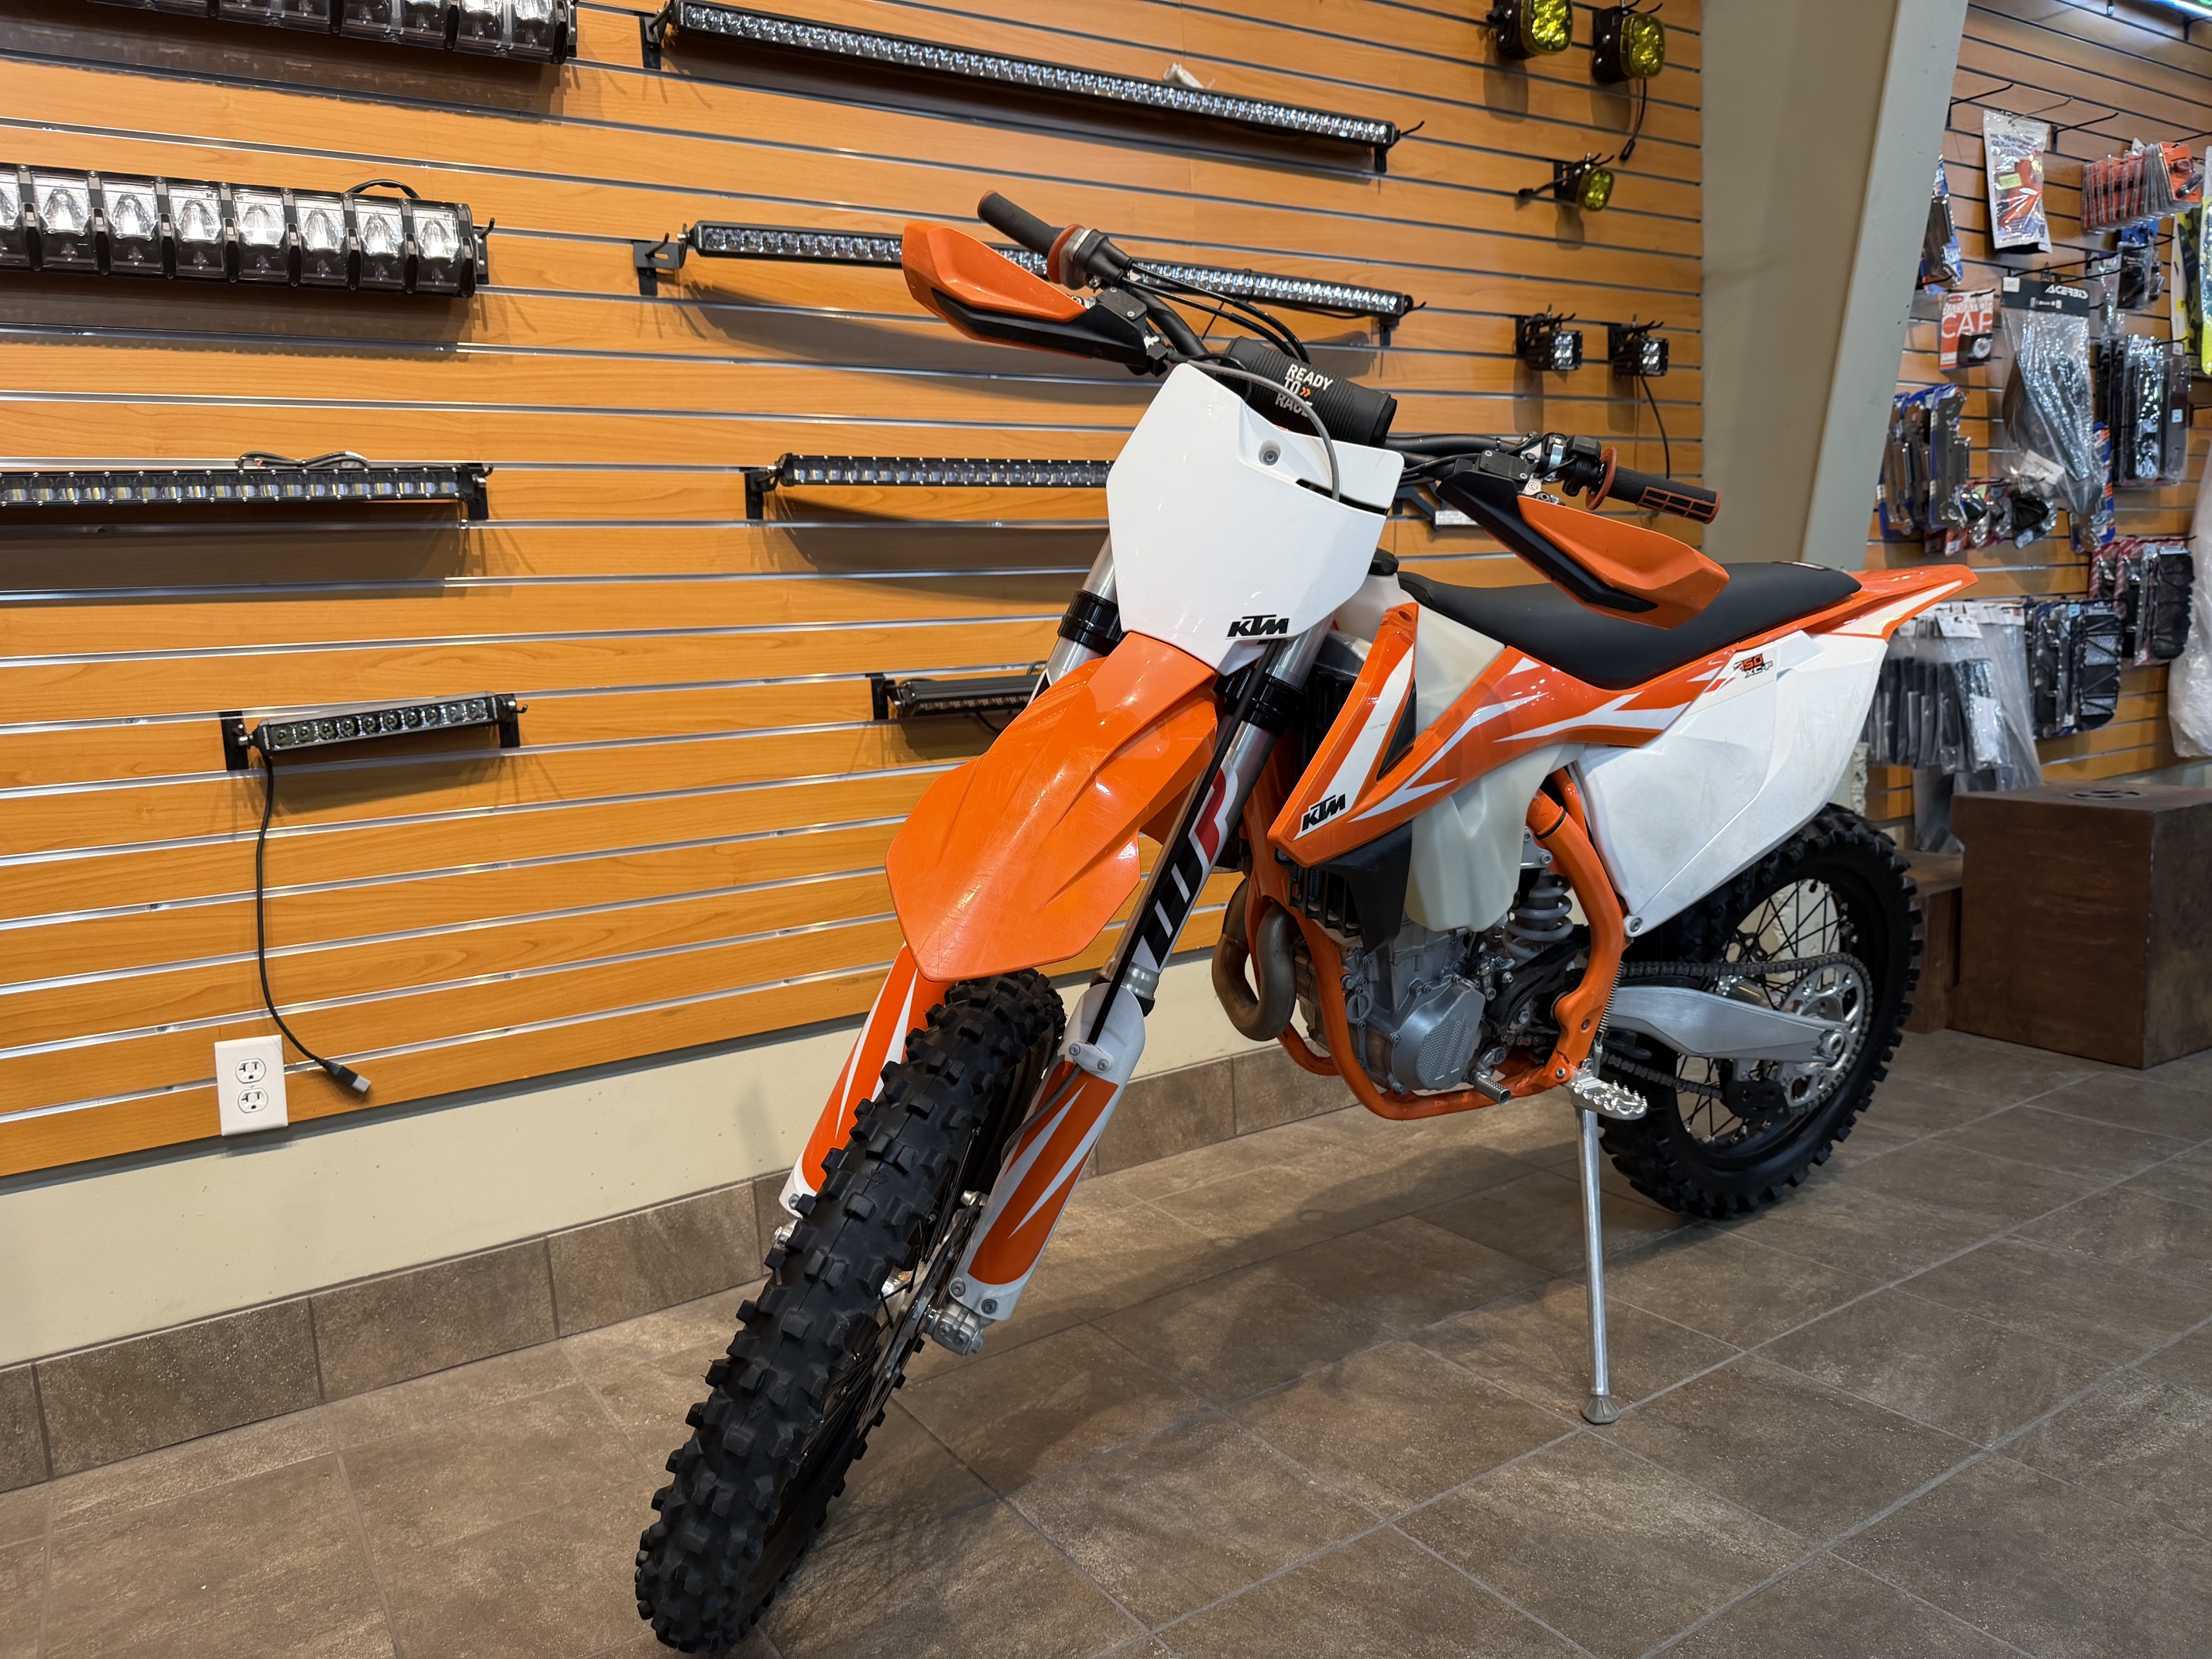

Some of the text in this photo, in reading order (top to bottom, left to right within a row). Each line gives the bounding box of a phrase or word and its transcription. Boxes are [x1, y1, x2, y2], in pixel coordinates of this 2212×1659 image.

[2045, 284, 2089, 300] ACERBIS
[1284, 376, 1302, 396] TO
[1285, 363, 1334, 390] READY
[1227, 614, 1290, 637] KTM
[1745, 661, 1773, 678] XC-F
[1302, 793, 1345, 832] KTM
